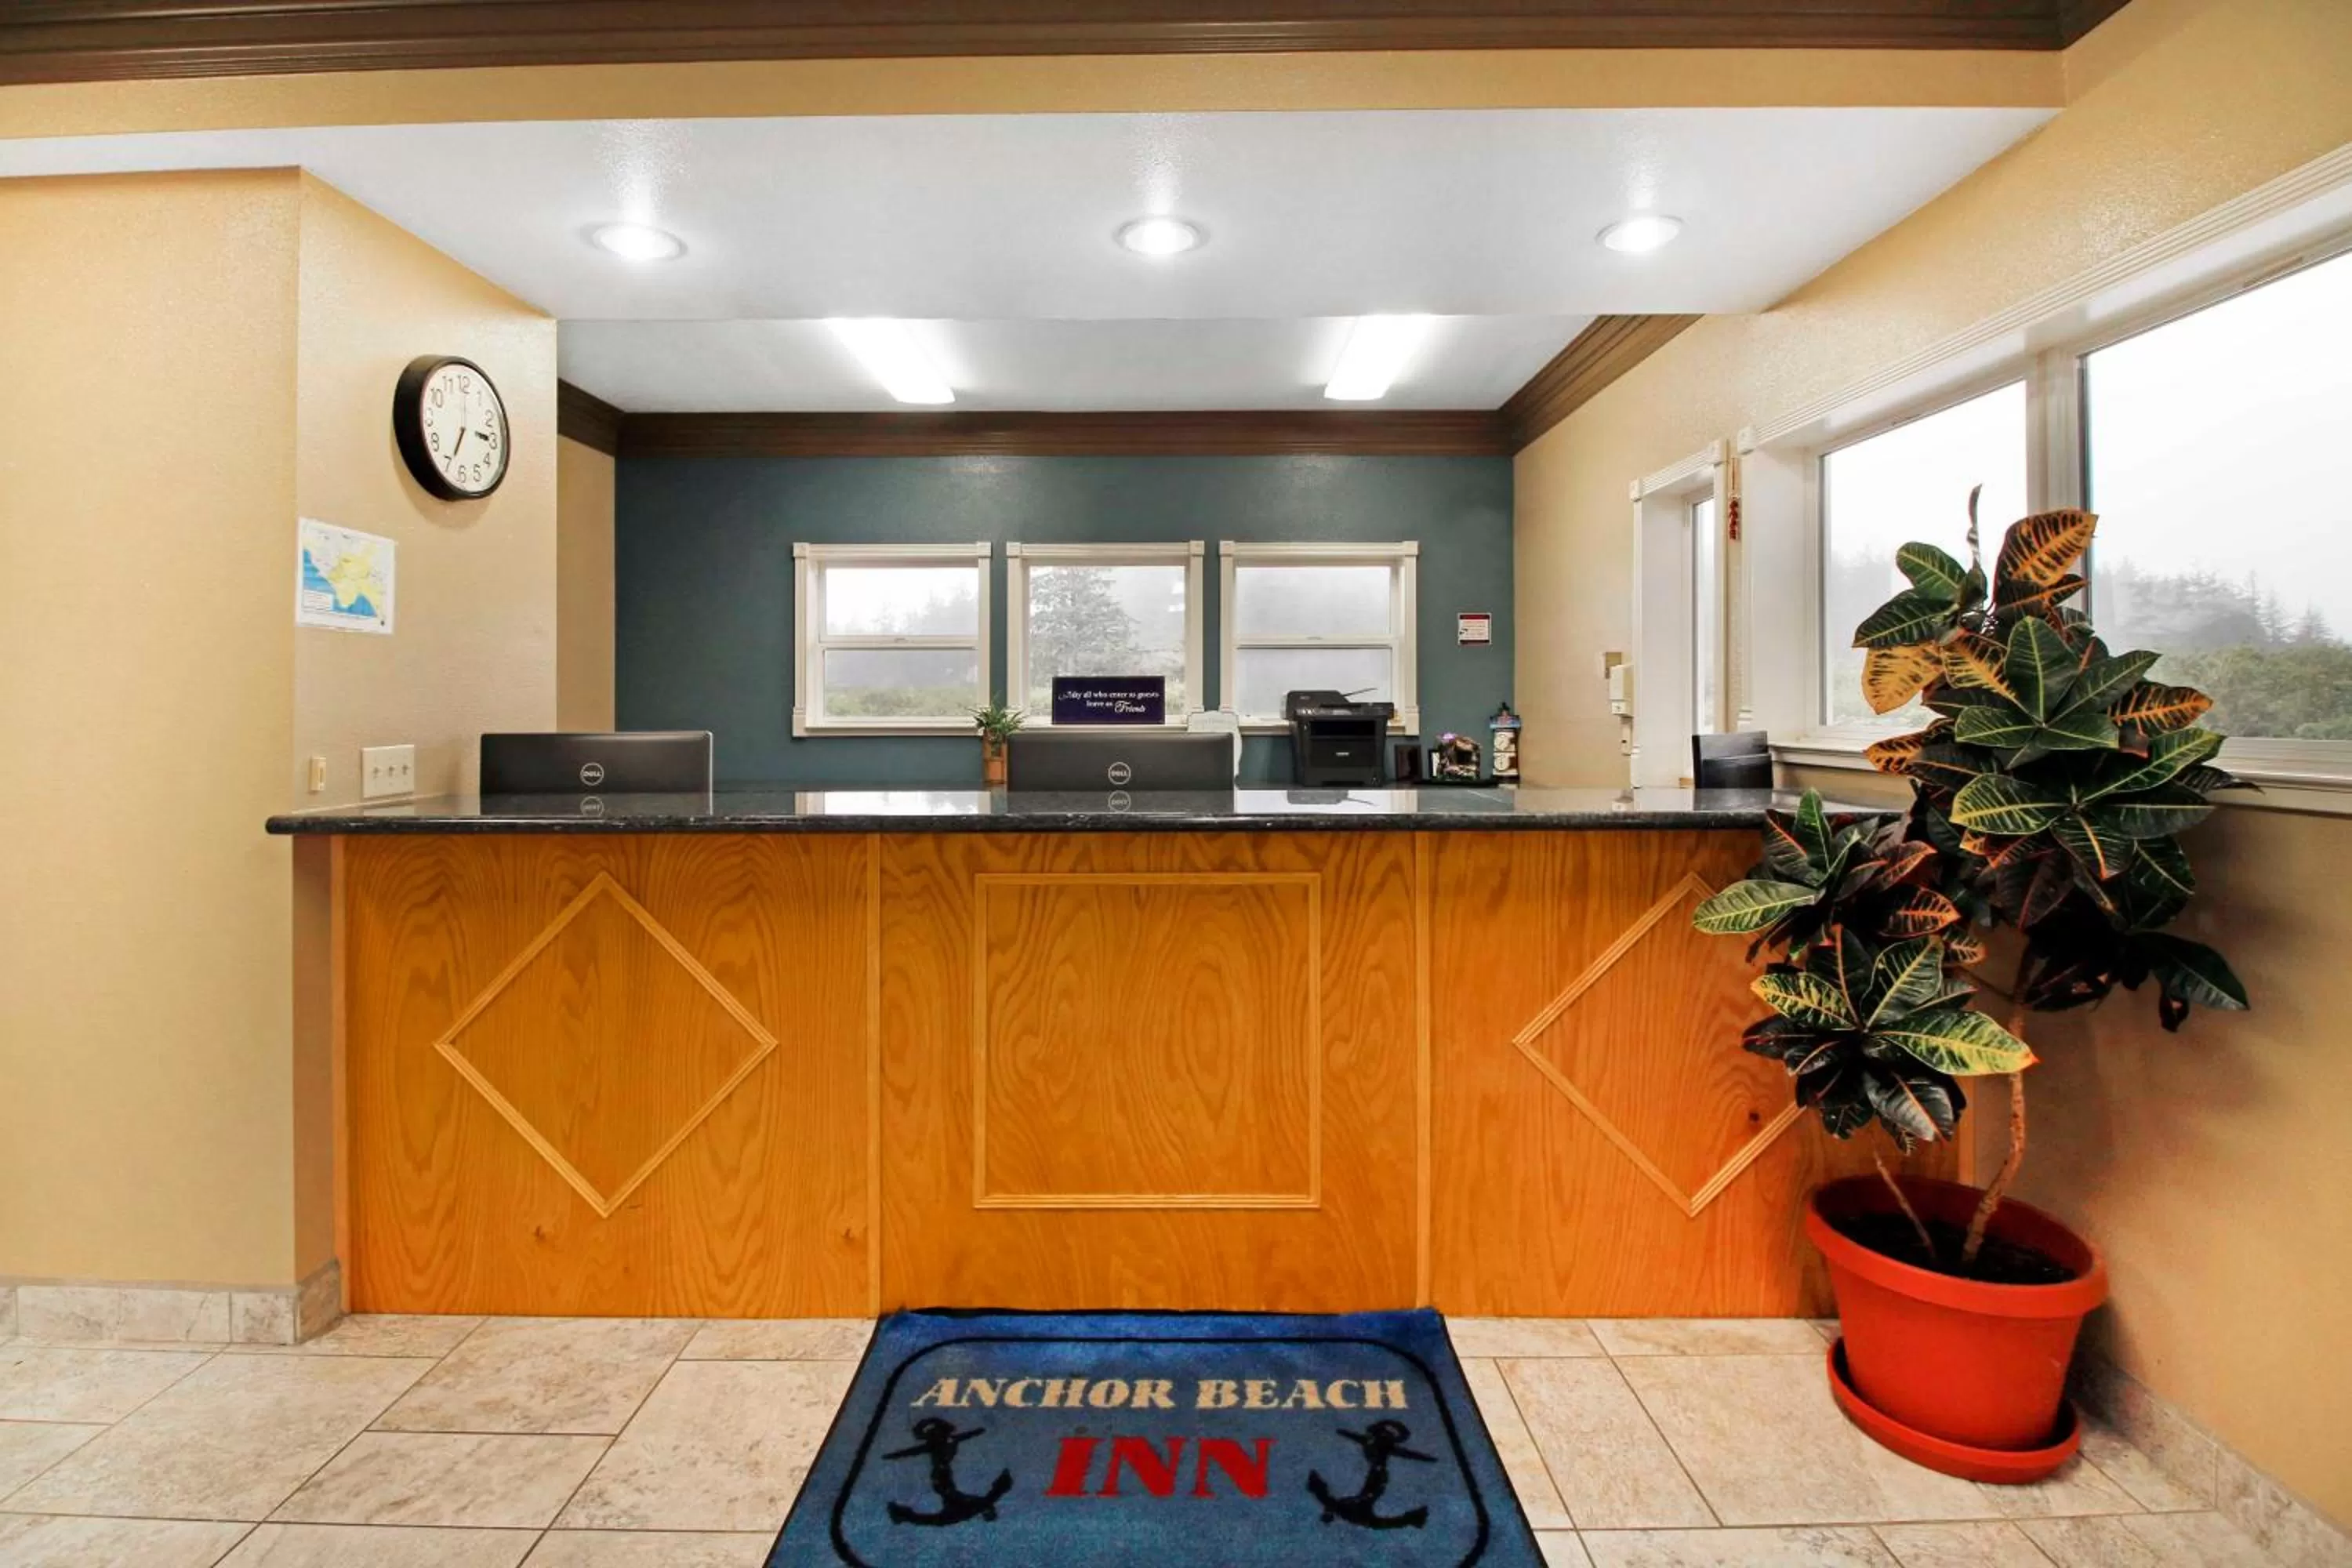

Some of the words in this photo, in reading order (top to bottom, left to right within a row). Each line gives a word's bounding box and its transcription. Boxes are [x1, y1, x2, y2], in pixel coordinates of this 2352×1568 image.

[458, 376, 470, 394] 12
[430, 388, 444, 408] 10
[485, 409, 493, 427] 2
[431, 433, 440, 452] 8
[488, 433, 497, 450] 3
[444, 455, 452, 472] 7
[483, 453, 491, 467] 4
[457, 465, 466, 483] 6
[473, 464, 482, 481] 5
[909, 1377, 1175, 1408] ANCHOR
[1195, 1378, 1409, 1409] BEACH
[1044, 1436, 1278, 1500] INN
